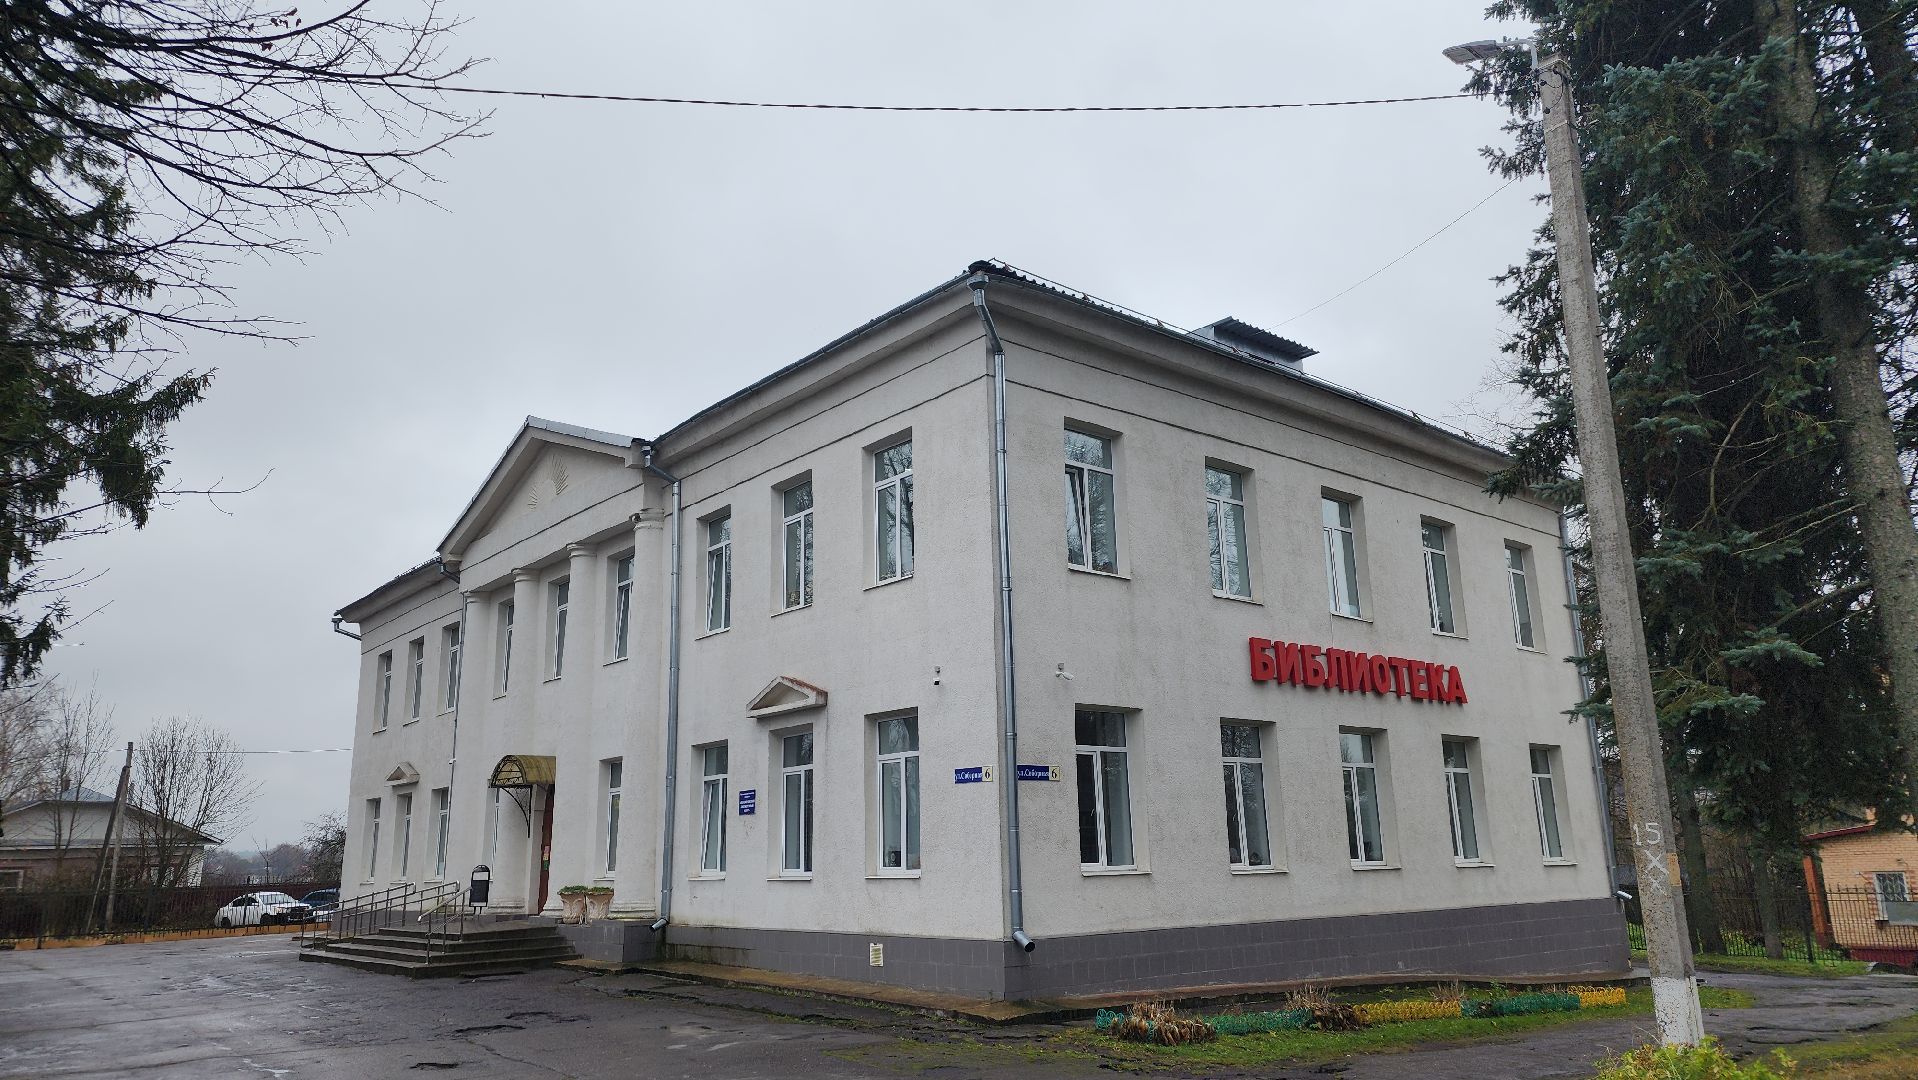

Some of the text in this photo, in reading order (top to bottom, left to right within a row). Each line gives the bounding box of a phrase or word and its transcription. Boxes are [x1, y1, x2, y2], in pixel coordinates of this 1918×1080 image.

[1249, 637, 1468, 703] БИБЛИОТЕКА
[984, 768, 991, 779] 6
[1051, 767, 1058, 779] 6
[1633, 823, 1661, 845] 15
